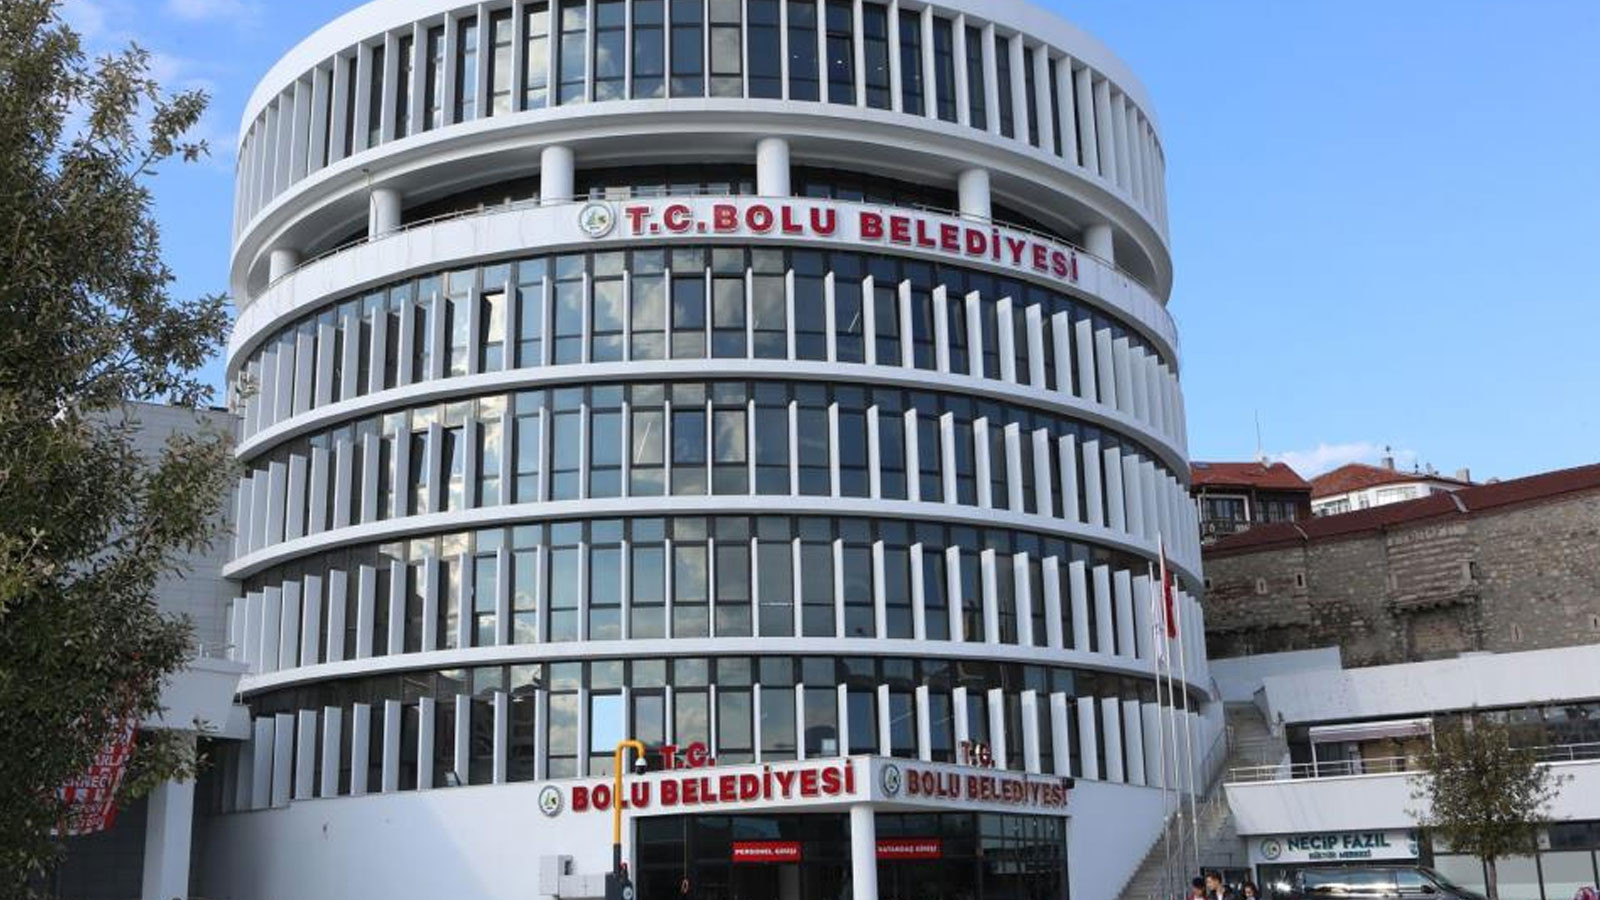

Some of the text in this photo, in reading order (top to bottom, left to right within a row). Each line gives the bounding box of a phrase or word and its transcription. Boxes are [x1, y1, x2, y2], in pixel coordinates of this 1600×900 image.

[859, 211, 1079, 283] BELEDİYESİ
[660, 742, 716, 770] T.C.
[660, 757, 855, 806] BELEDİYESİ
[907, 770, 961, 799] BOLU
[1288, 832, 1391, 851] NECİP FAZIL
